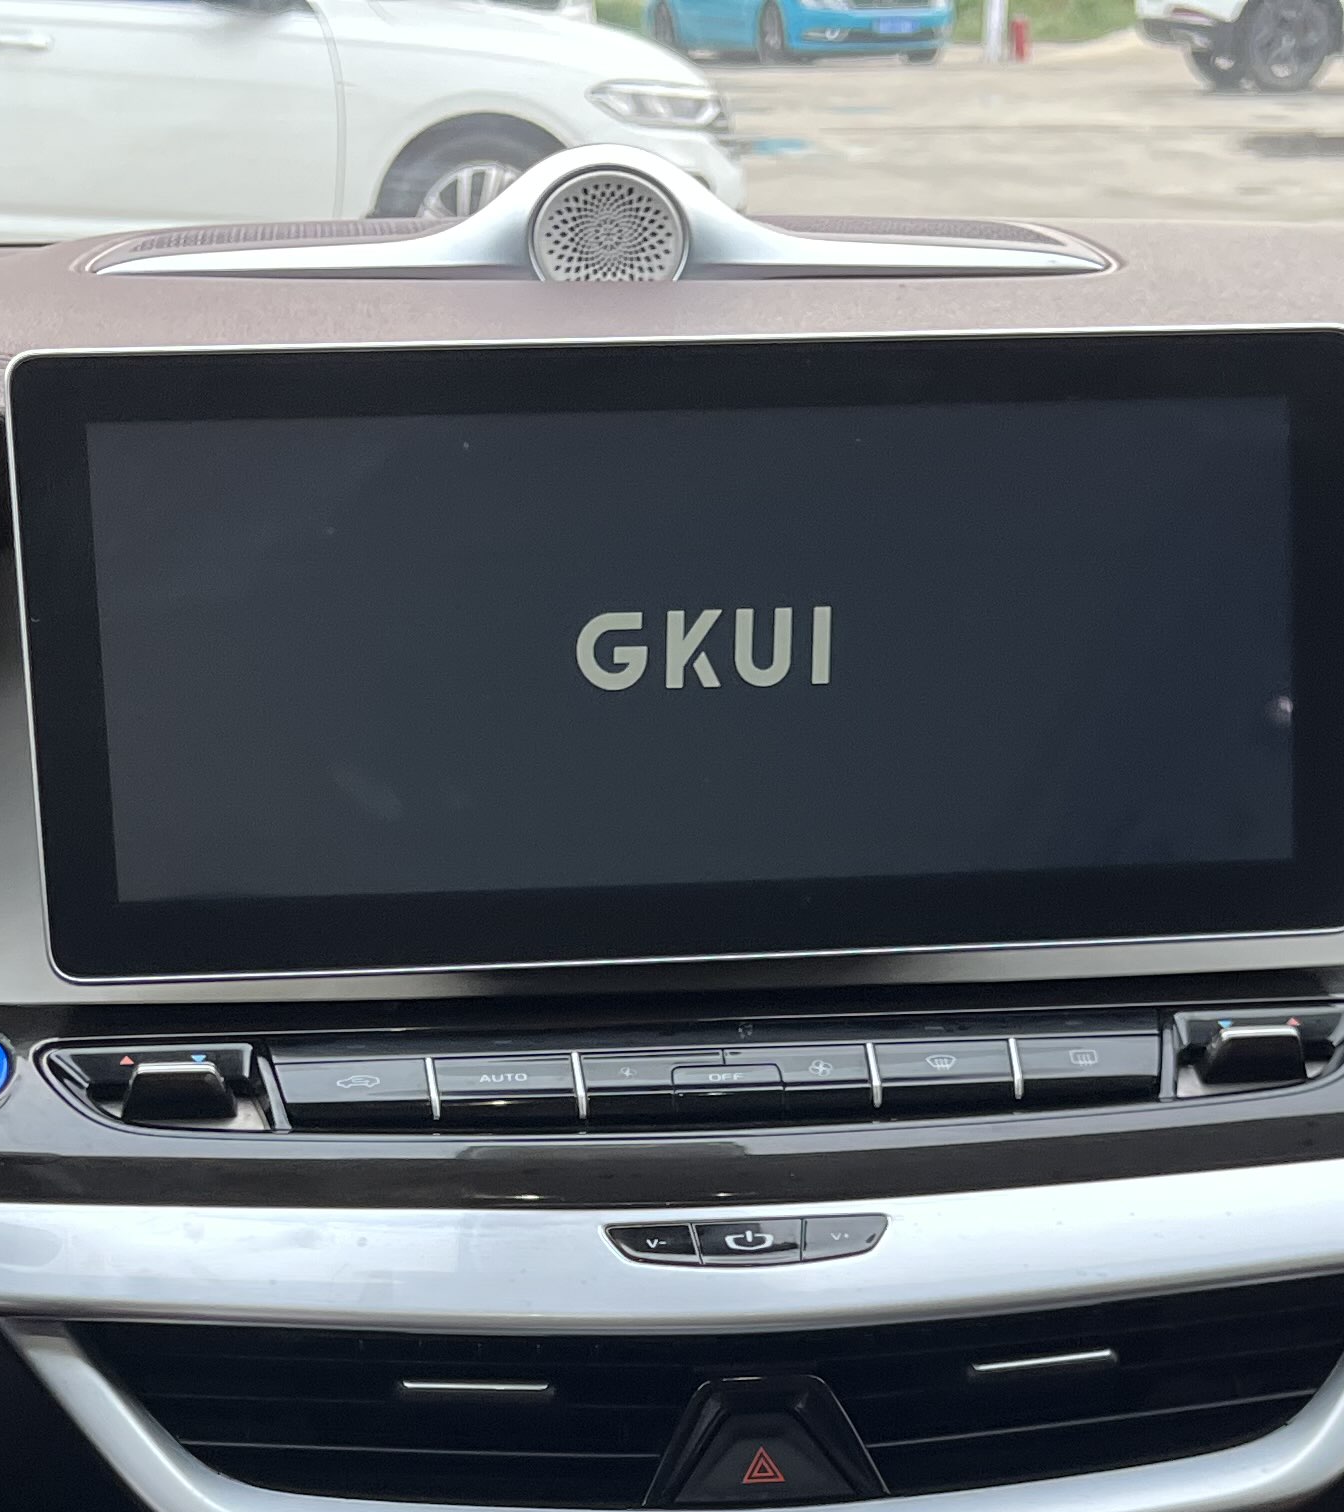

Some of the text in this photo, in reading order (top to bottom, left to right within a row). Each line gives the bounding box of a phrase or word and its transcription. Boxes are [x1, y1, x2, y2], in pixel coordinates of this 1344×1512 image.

[576, 606, 832, 691] GKUI
[479, 1072, 528, 1083] AUTO
[708, 1072, 745, 1082] OFF
